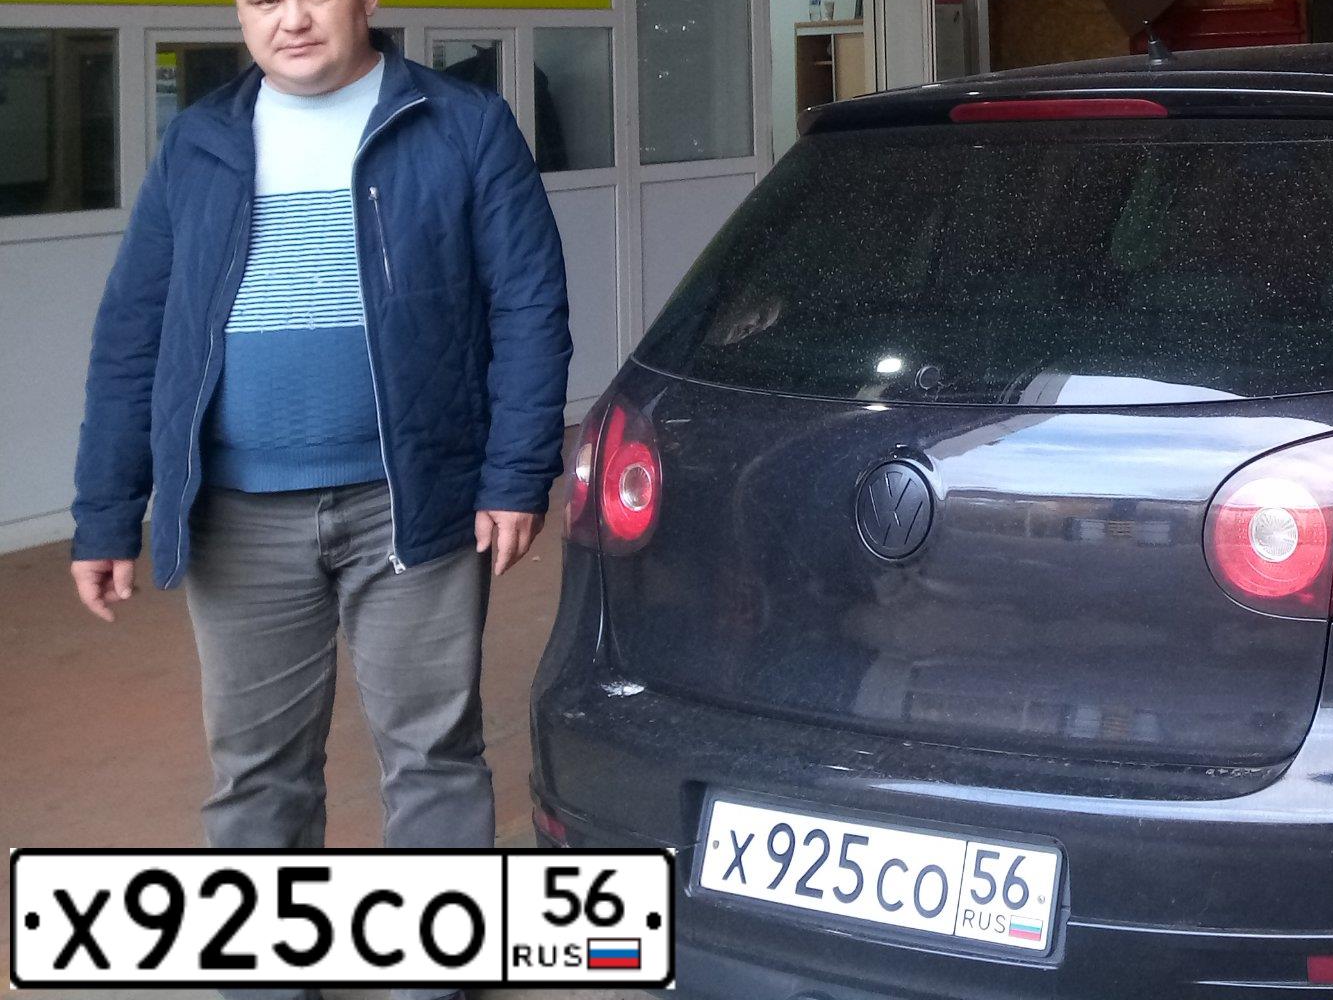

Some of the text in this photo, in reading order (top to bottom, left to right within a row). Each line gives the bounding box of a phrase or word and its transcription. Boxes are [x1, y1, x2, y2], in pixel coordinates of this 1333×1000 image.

[722, 822, 1030, 919] Х925СО 56
[962, 909, 1006, 934] RUS
